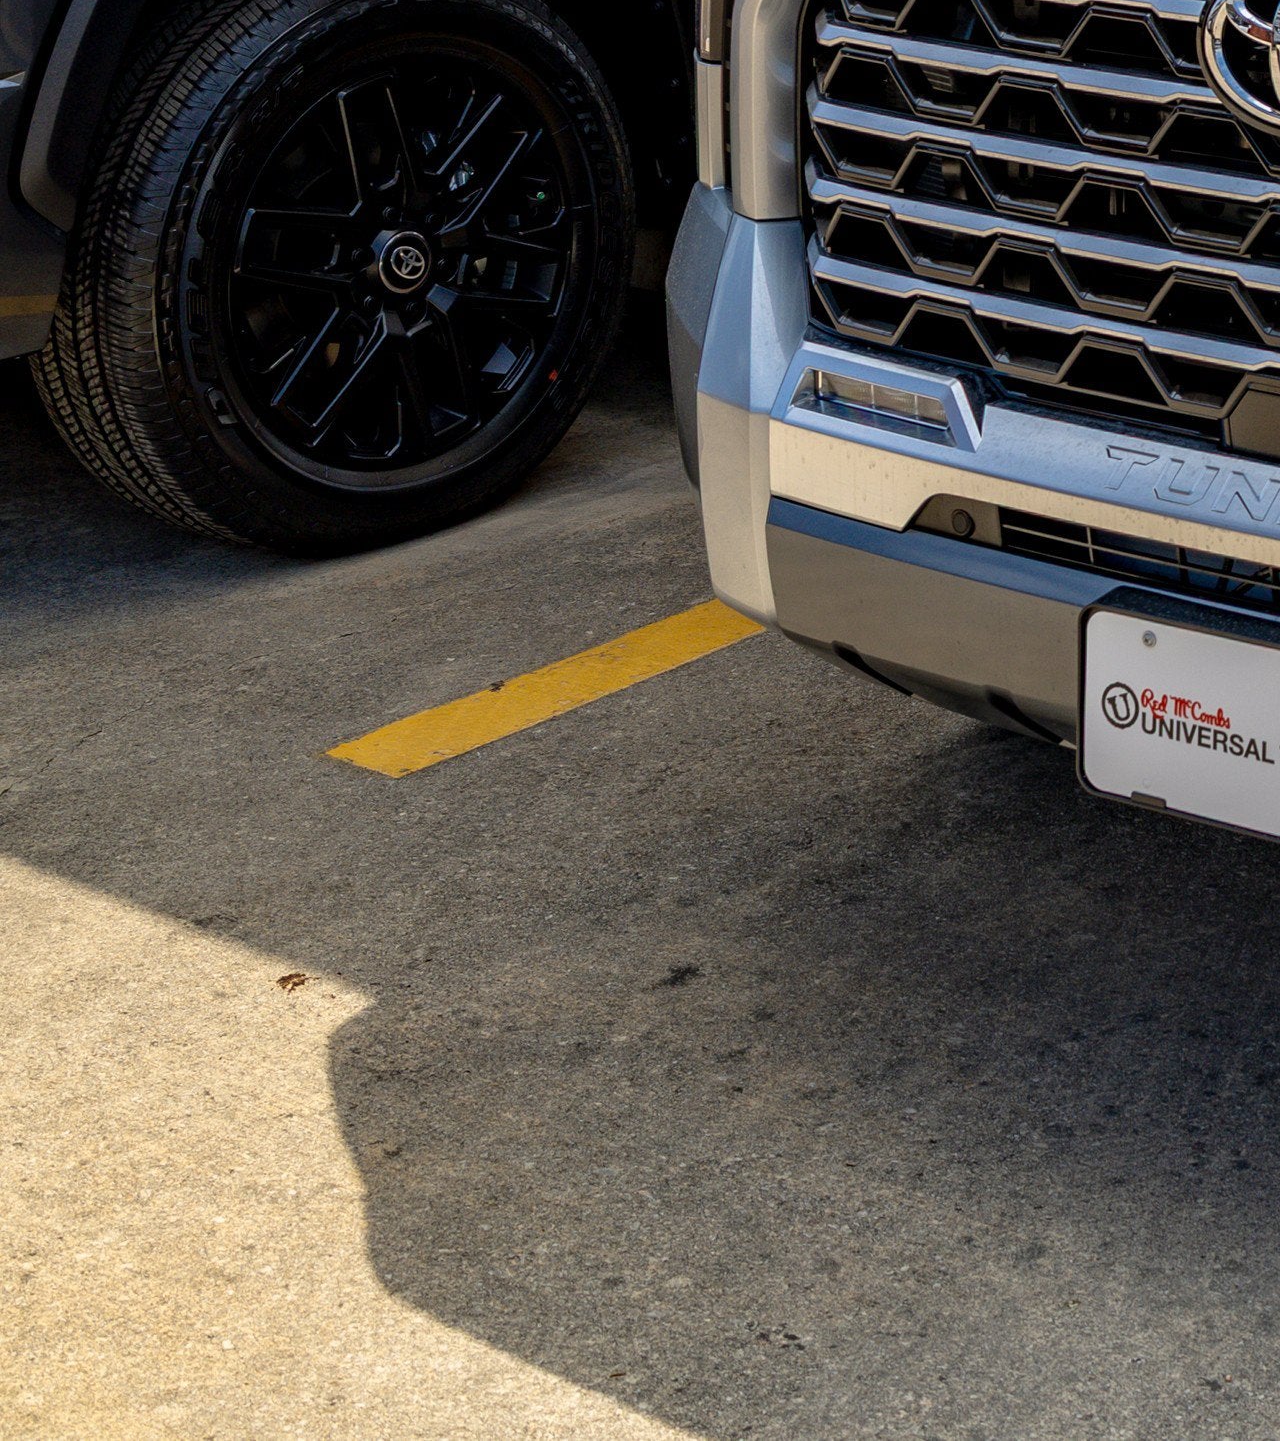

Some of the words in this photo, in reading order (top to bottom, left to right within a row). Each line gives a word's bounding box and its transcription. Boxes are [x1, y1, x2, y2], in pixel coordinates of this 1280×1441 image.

[1141, 689, 1167, 714] Red
[1170, 696, 1231, 729] McCombs
[1141, 711, 1275, 764] UNIVERSAL
